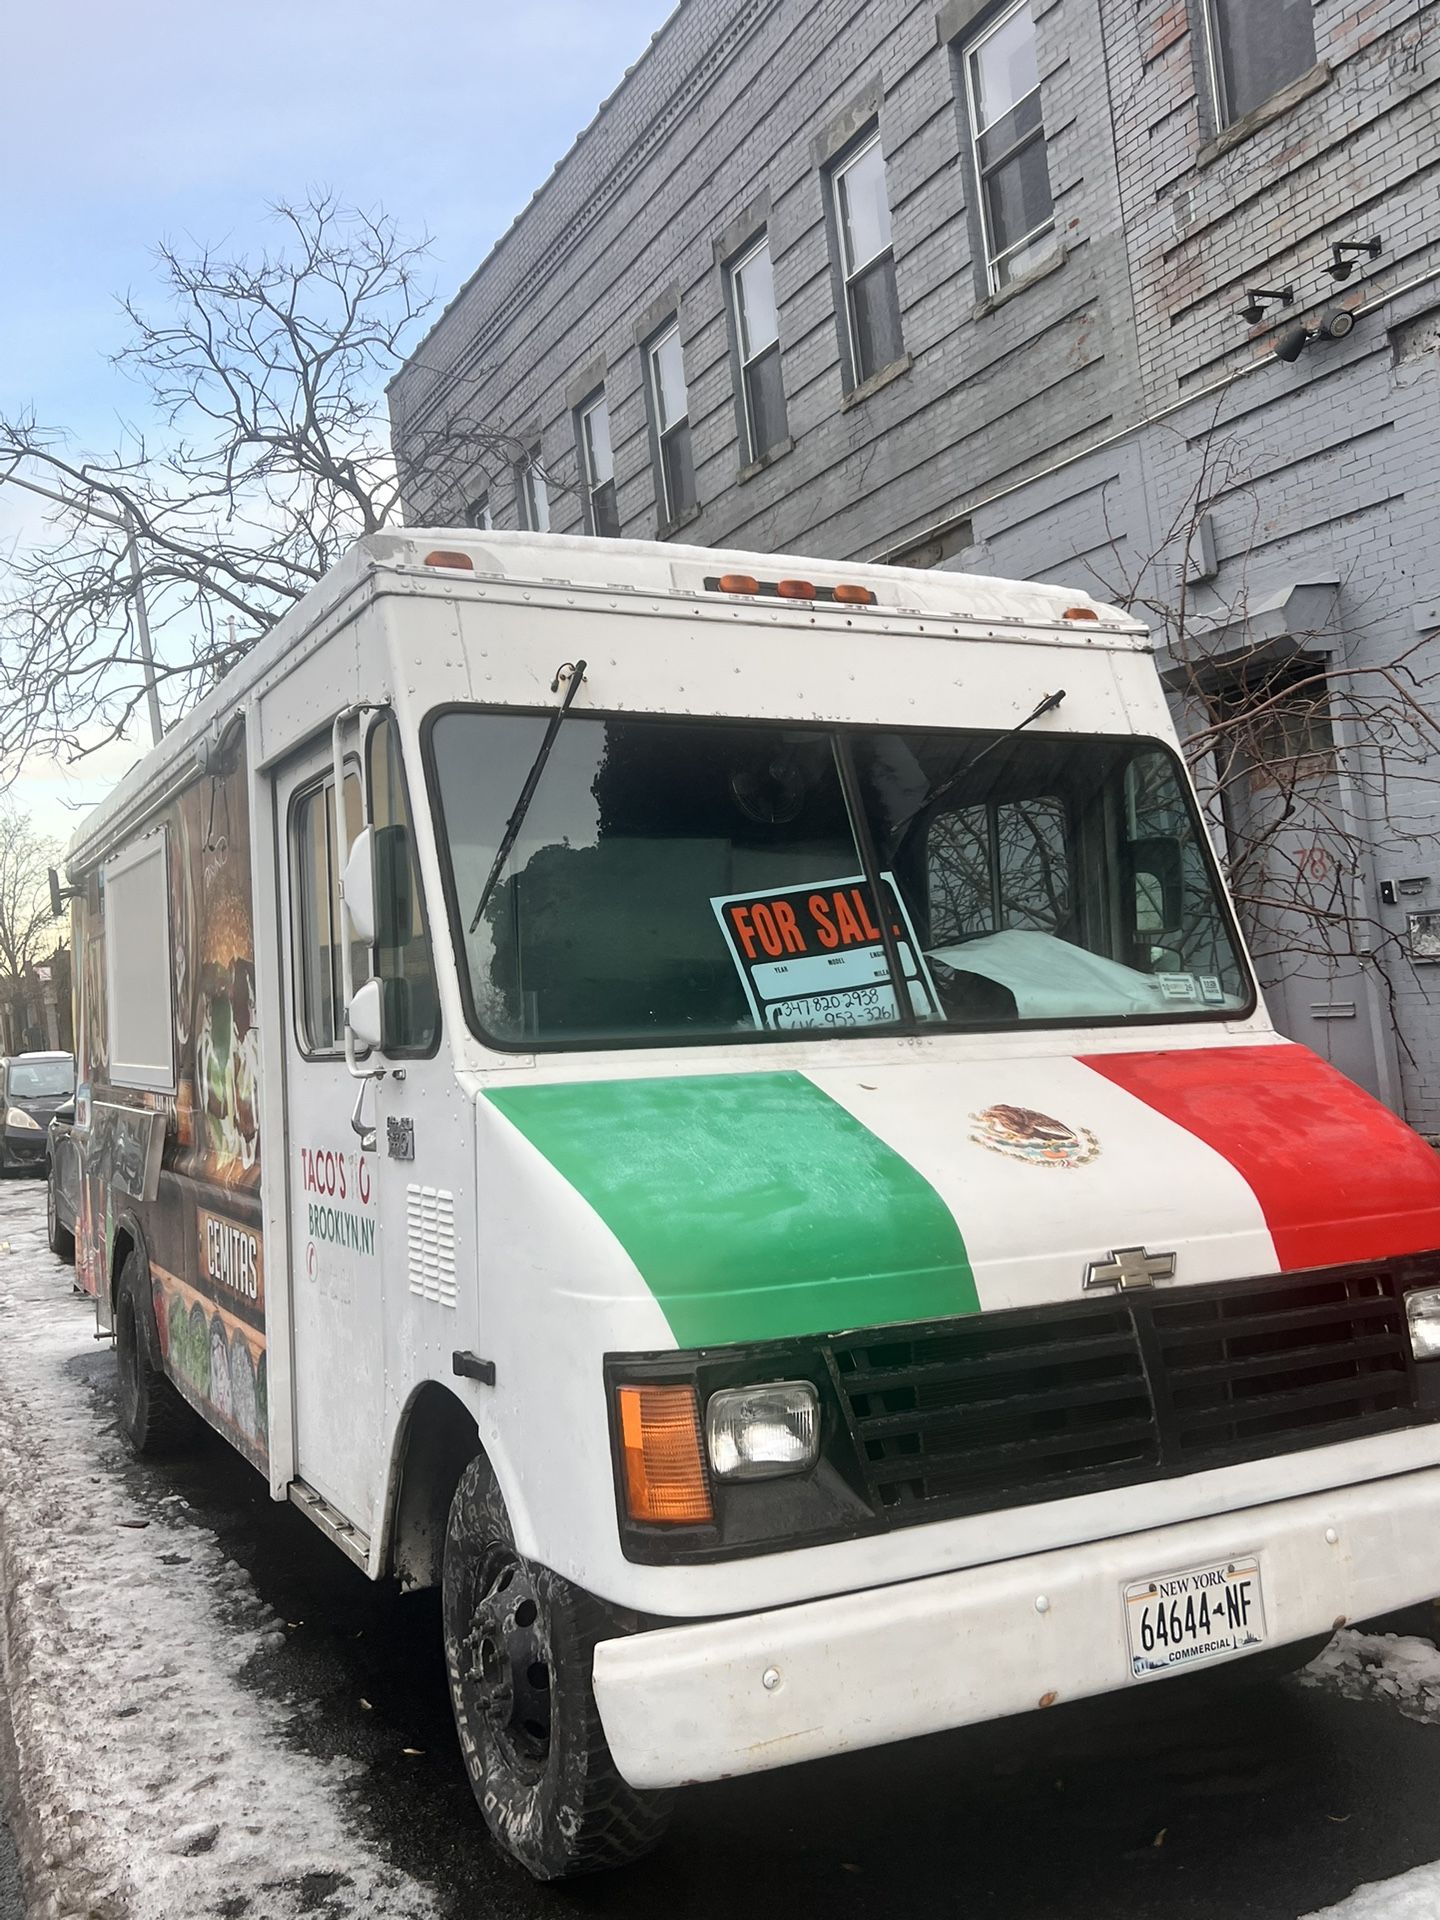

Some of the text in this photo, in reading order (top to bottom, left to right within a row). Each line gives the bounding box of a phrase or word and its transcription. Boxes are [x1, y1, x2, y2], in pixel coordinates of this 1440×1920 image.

[730, 889, 900, 959] FOR SAL
[774, 950, 887, 974] YEAR MODEL ENGIN
[873, 969, 890, 977] MILEA
[301, 1148, 347, 1199] TACO'S
[207, 1217, 257, 1300] CEMITAS
[1159, 1569, 1226, 1598] NEW YORK
[1168, 1638, 1231, 1662] COMMERCIAL
